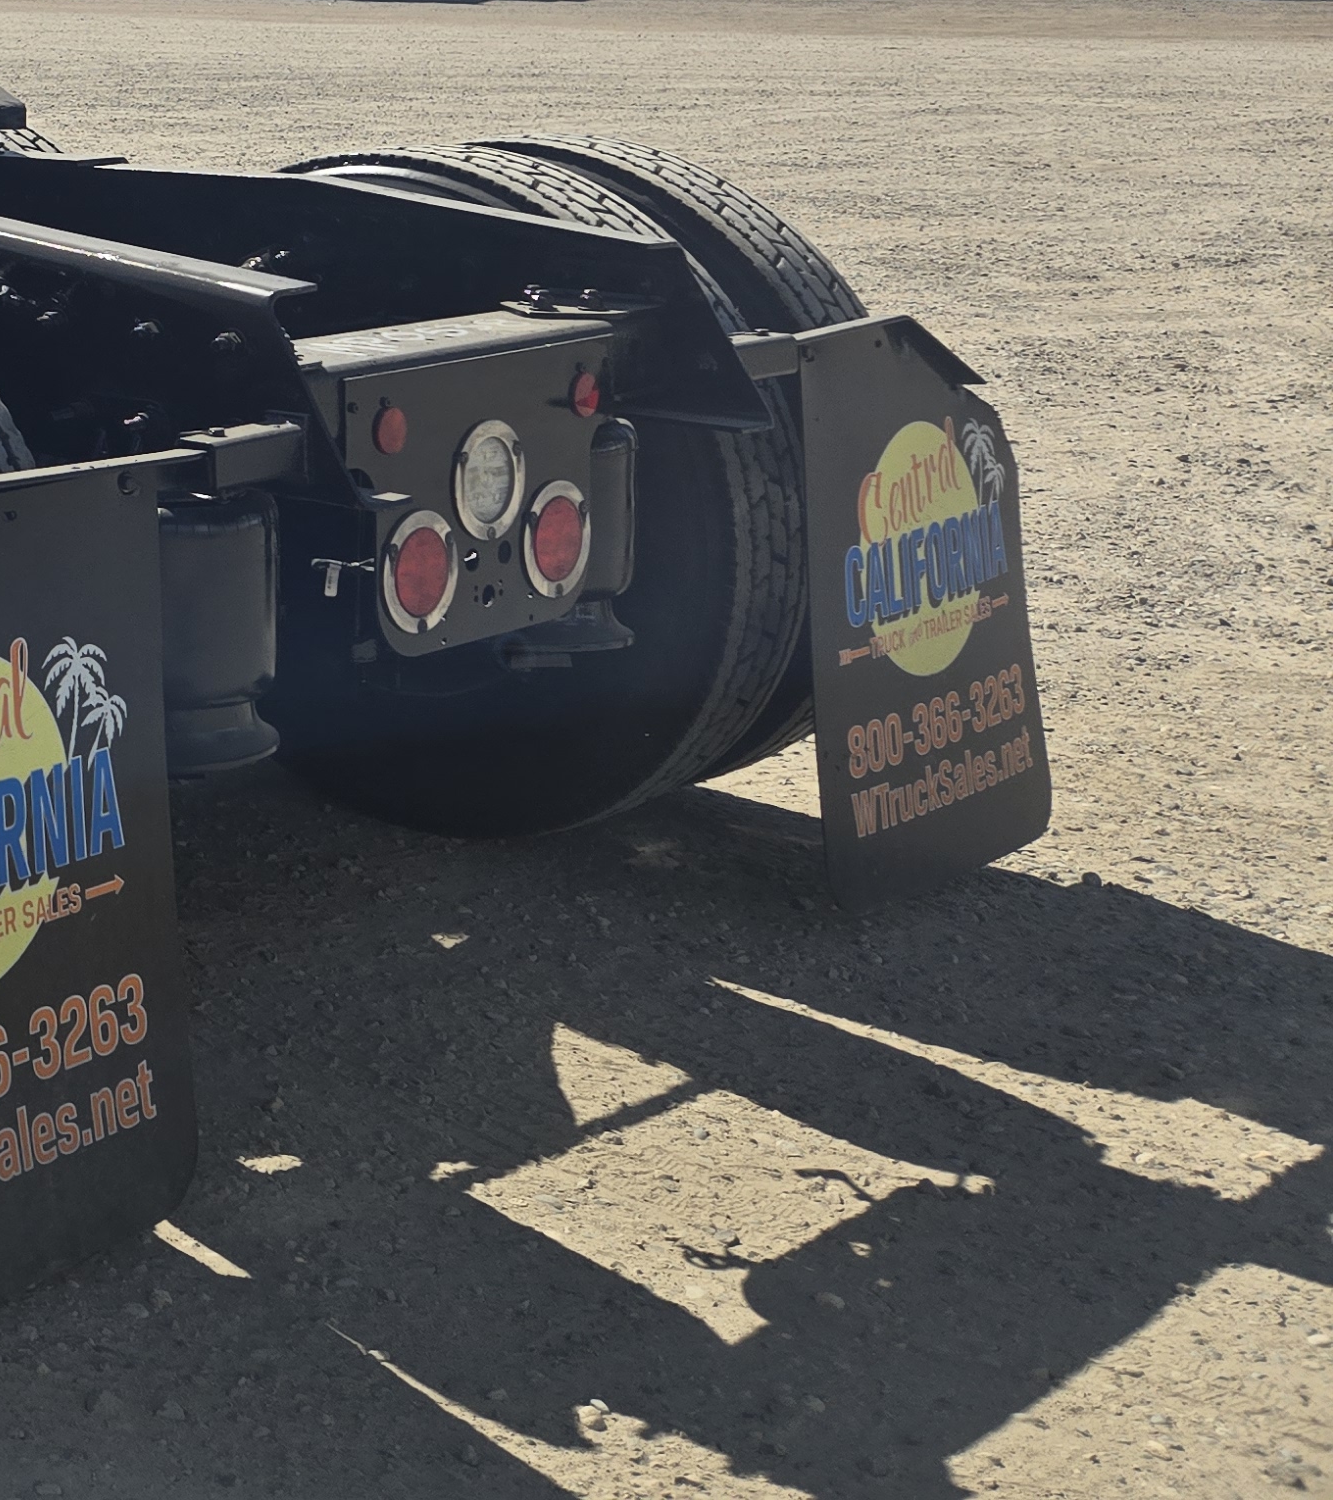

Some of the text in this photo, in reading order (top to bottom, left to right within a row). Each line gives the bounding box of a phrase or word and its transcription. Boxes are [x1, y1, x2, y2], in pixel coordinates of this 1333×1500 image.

[858, 416, 961, 546] Central
[845, 500, 1008, 628] CALIFORNIA
[869, 628, 907, 659] TRUCK
[923, 609, 962, 639] TRAILER
[964, 596, 992, 623] SALES
[848, 664, 1025, 779] 800-366-3263
[851, 725, 1033, 838] WTruckSales.net
[23, 884, 82, 929] SALES
